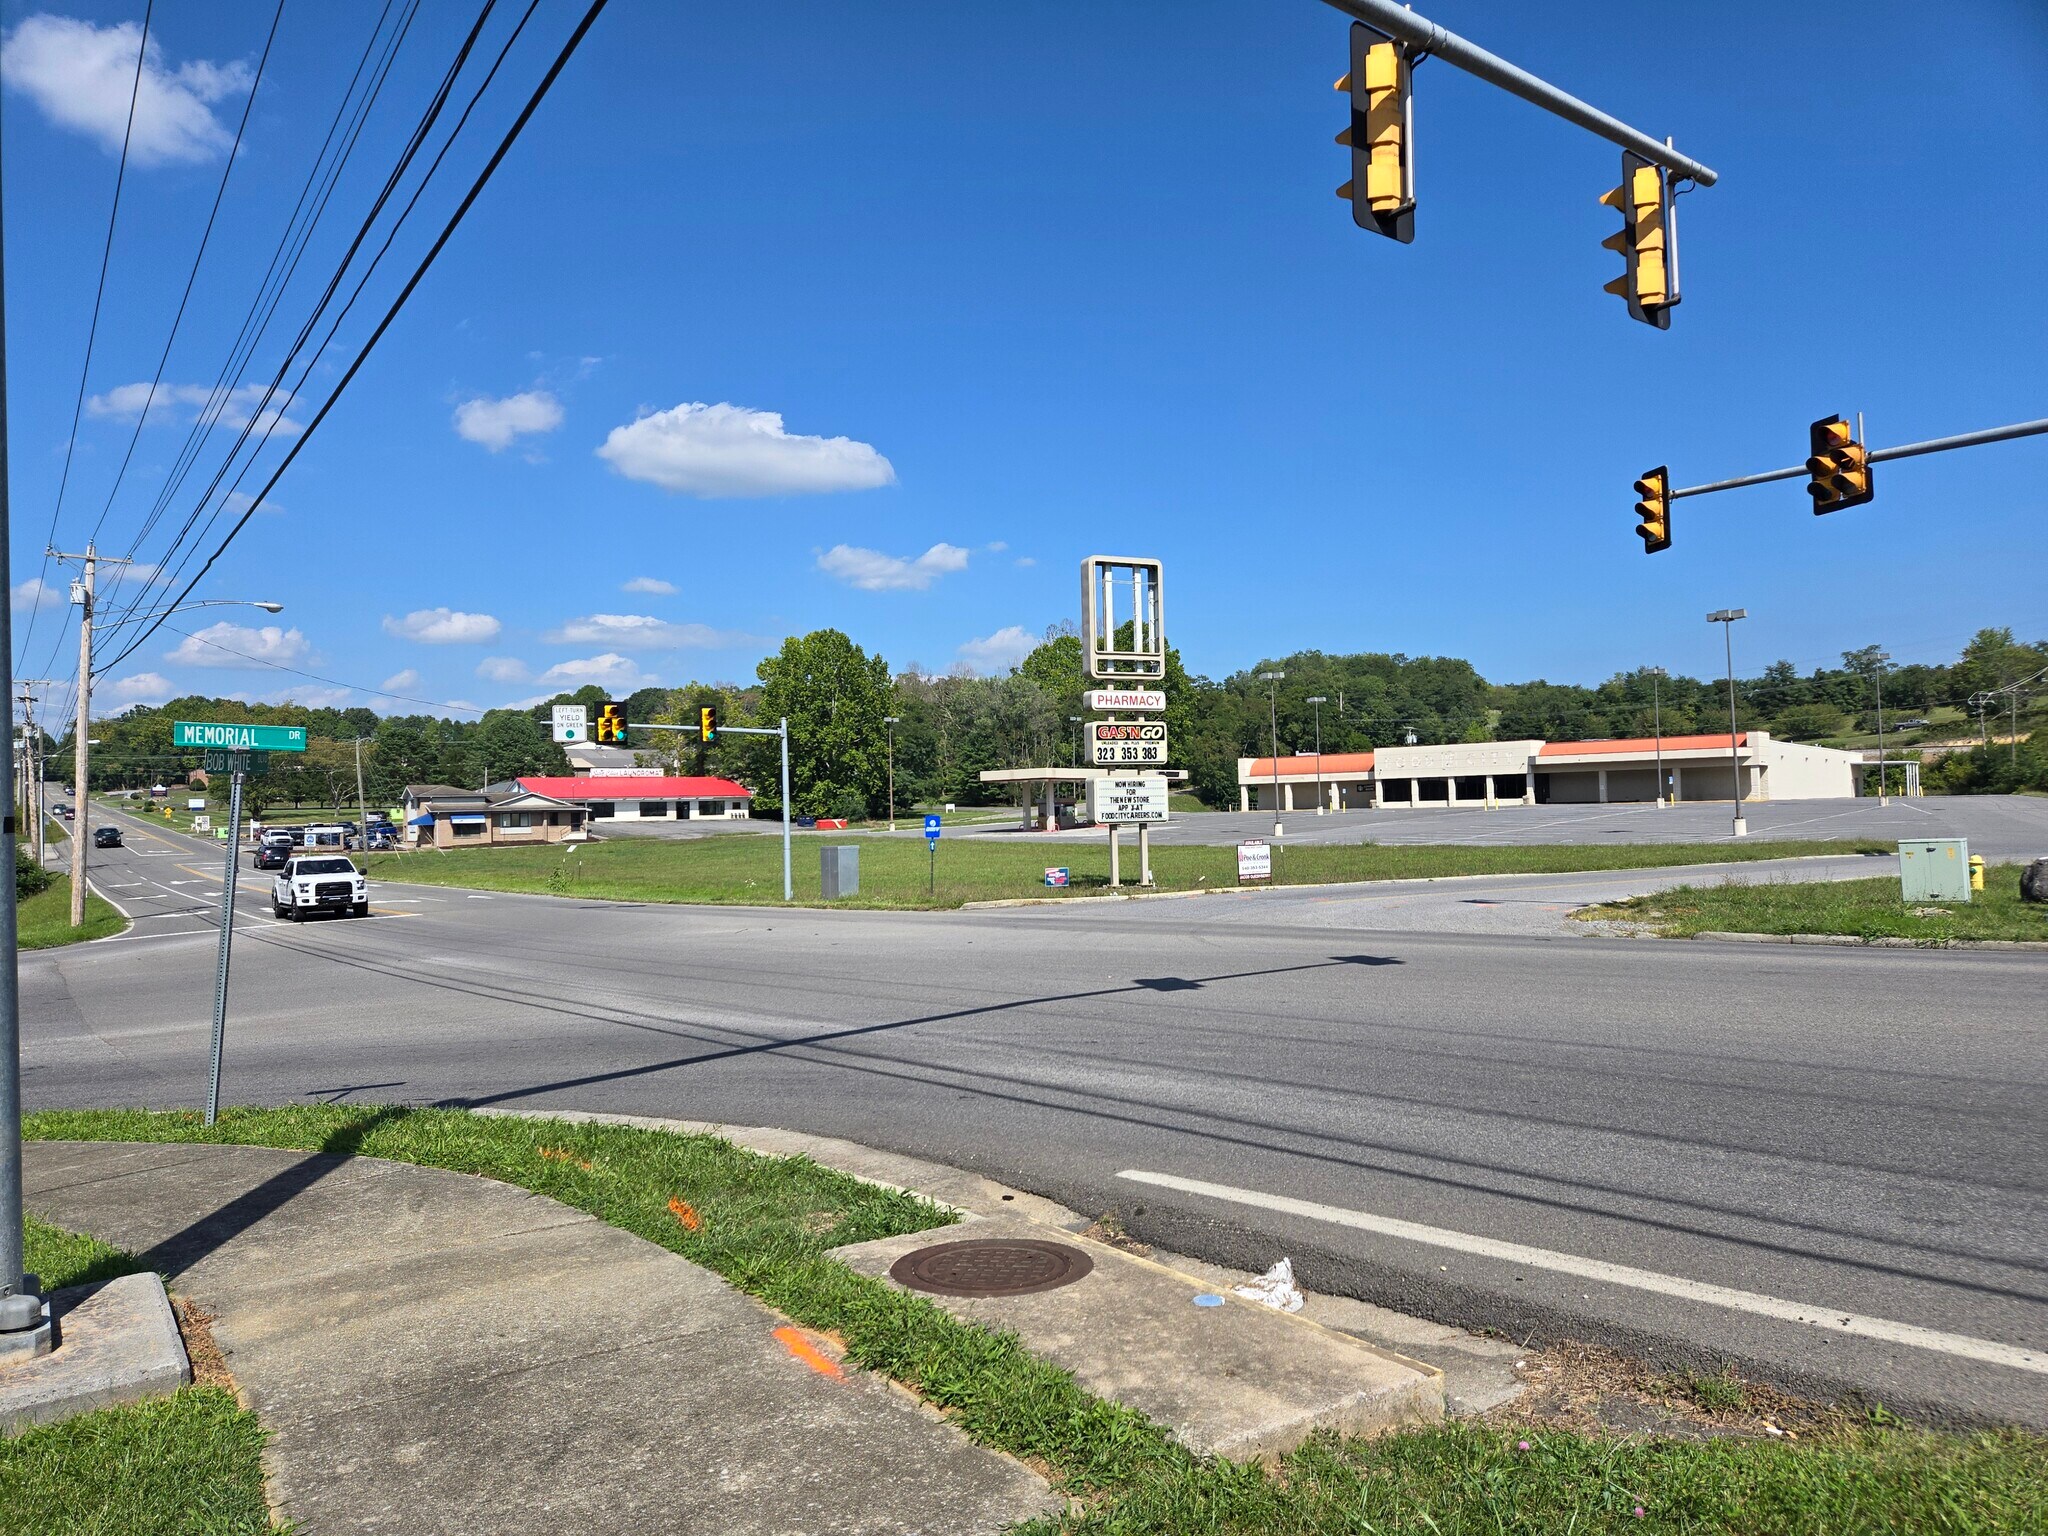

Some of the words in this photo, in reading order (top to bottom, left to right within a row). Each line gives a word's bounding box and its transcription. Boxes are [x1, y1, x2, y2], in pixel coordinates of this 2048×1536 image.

[1097, 694, 1161, 706] PHARMACY
[184, 725, 259, 746] MEMORIAL
[288, 730, 301, 740] DR
[1097, 747, 1115, 760] 323
[1121, 747, 1138, 760] 353
[1142, 747, 1157, 760] 383
[205, 753, 225, 771] BOB
[227, 753, 251, 771] WHITE
[1133, 796, 1150, 804] STORE
[1101, 812, 1163, 820] FOODCITYCAREERS.COM
[1256, 853, 1270, 861] Cronk
